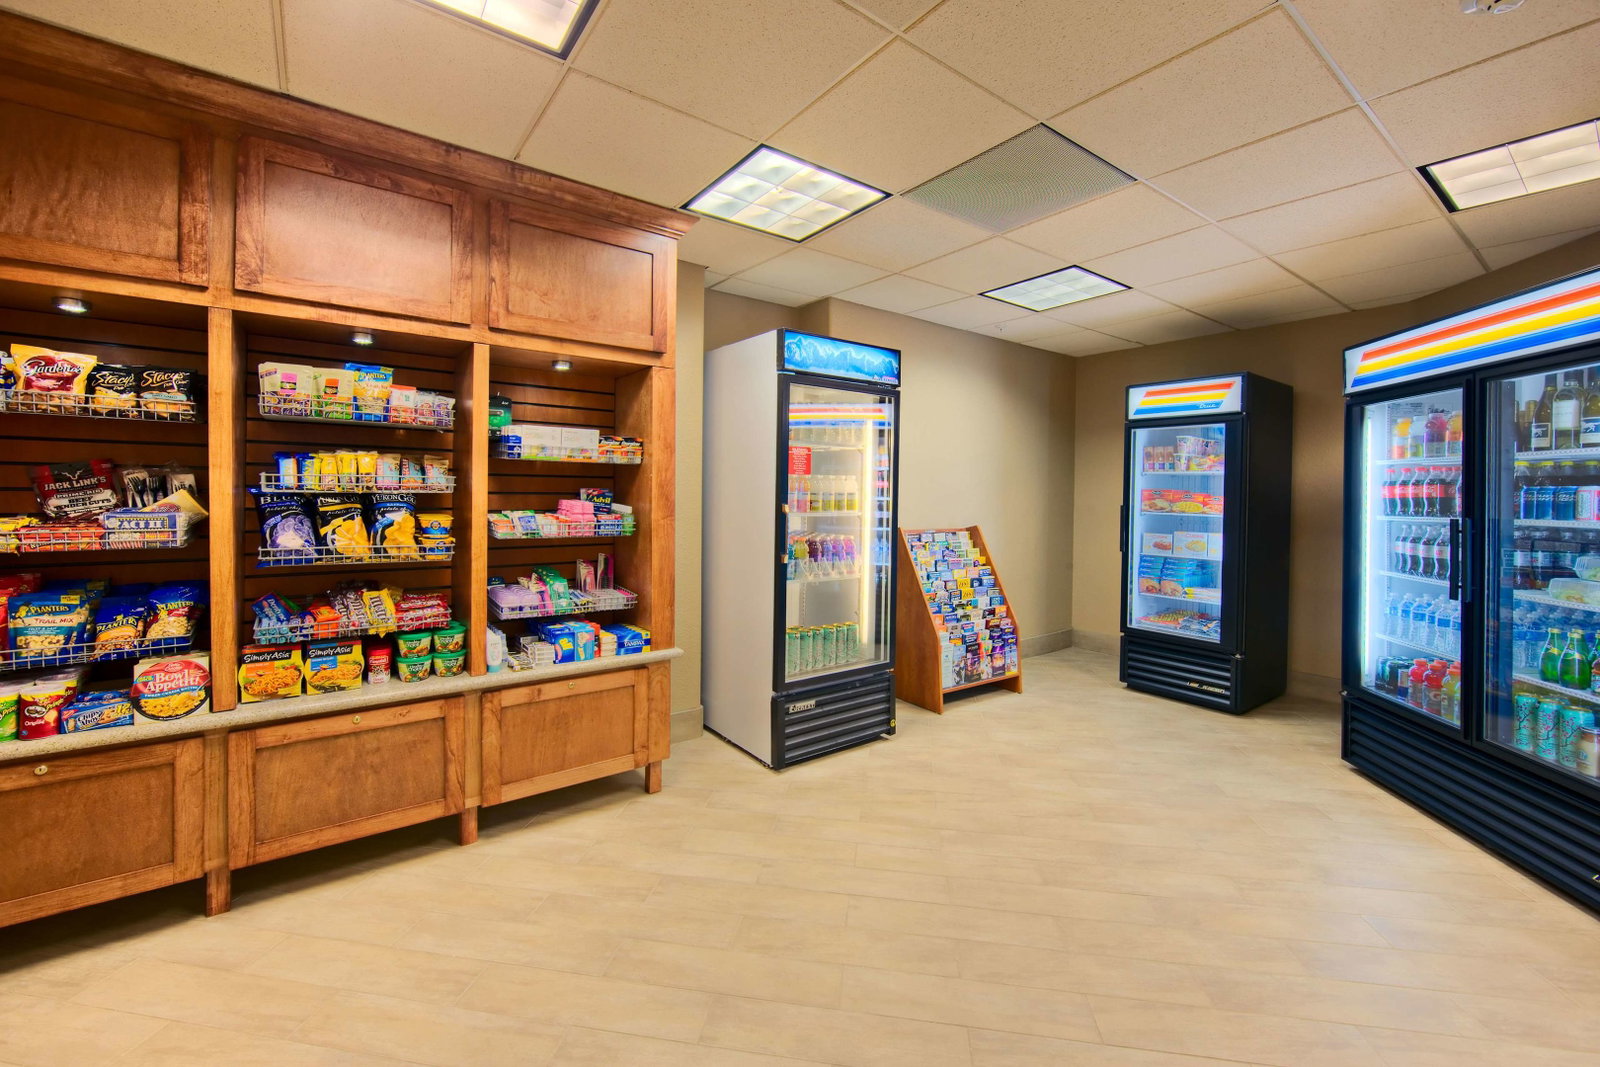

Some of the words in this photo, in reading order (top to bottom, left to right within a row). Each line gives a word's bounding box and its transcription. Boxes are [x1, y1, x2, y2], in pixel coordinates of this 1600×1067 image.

[92, 372, 135, 388] Stacy's
[140, 370, 184, 391] Stacy's
[44, 481, 71, 491] JACK
[73, 476, 107, 488] LINK'S
[371, 494, 398, 504] YUKON
[120, 520, 147, 529] ACT
[148, 520, 163, 528] II
[30, 606, 70, 614] PLANTERS
[156, 601, 194, 612] PLANTERS
[96, 616, 138, 633] PLANTERS
[623, 639, 646, 647] TAMPAX
[243, 653, 271, 664] Simply
[270, 651, 291, 659] Asia
[308, 647, 336, 658] Simply
[334, 645, 352, 654] Asia
[155, 669, 189, 683] Bowl
[78, 710, 101, 721] Chips
